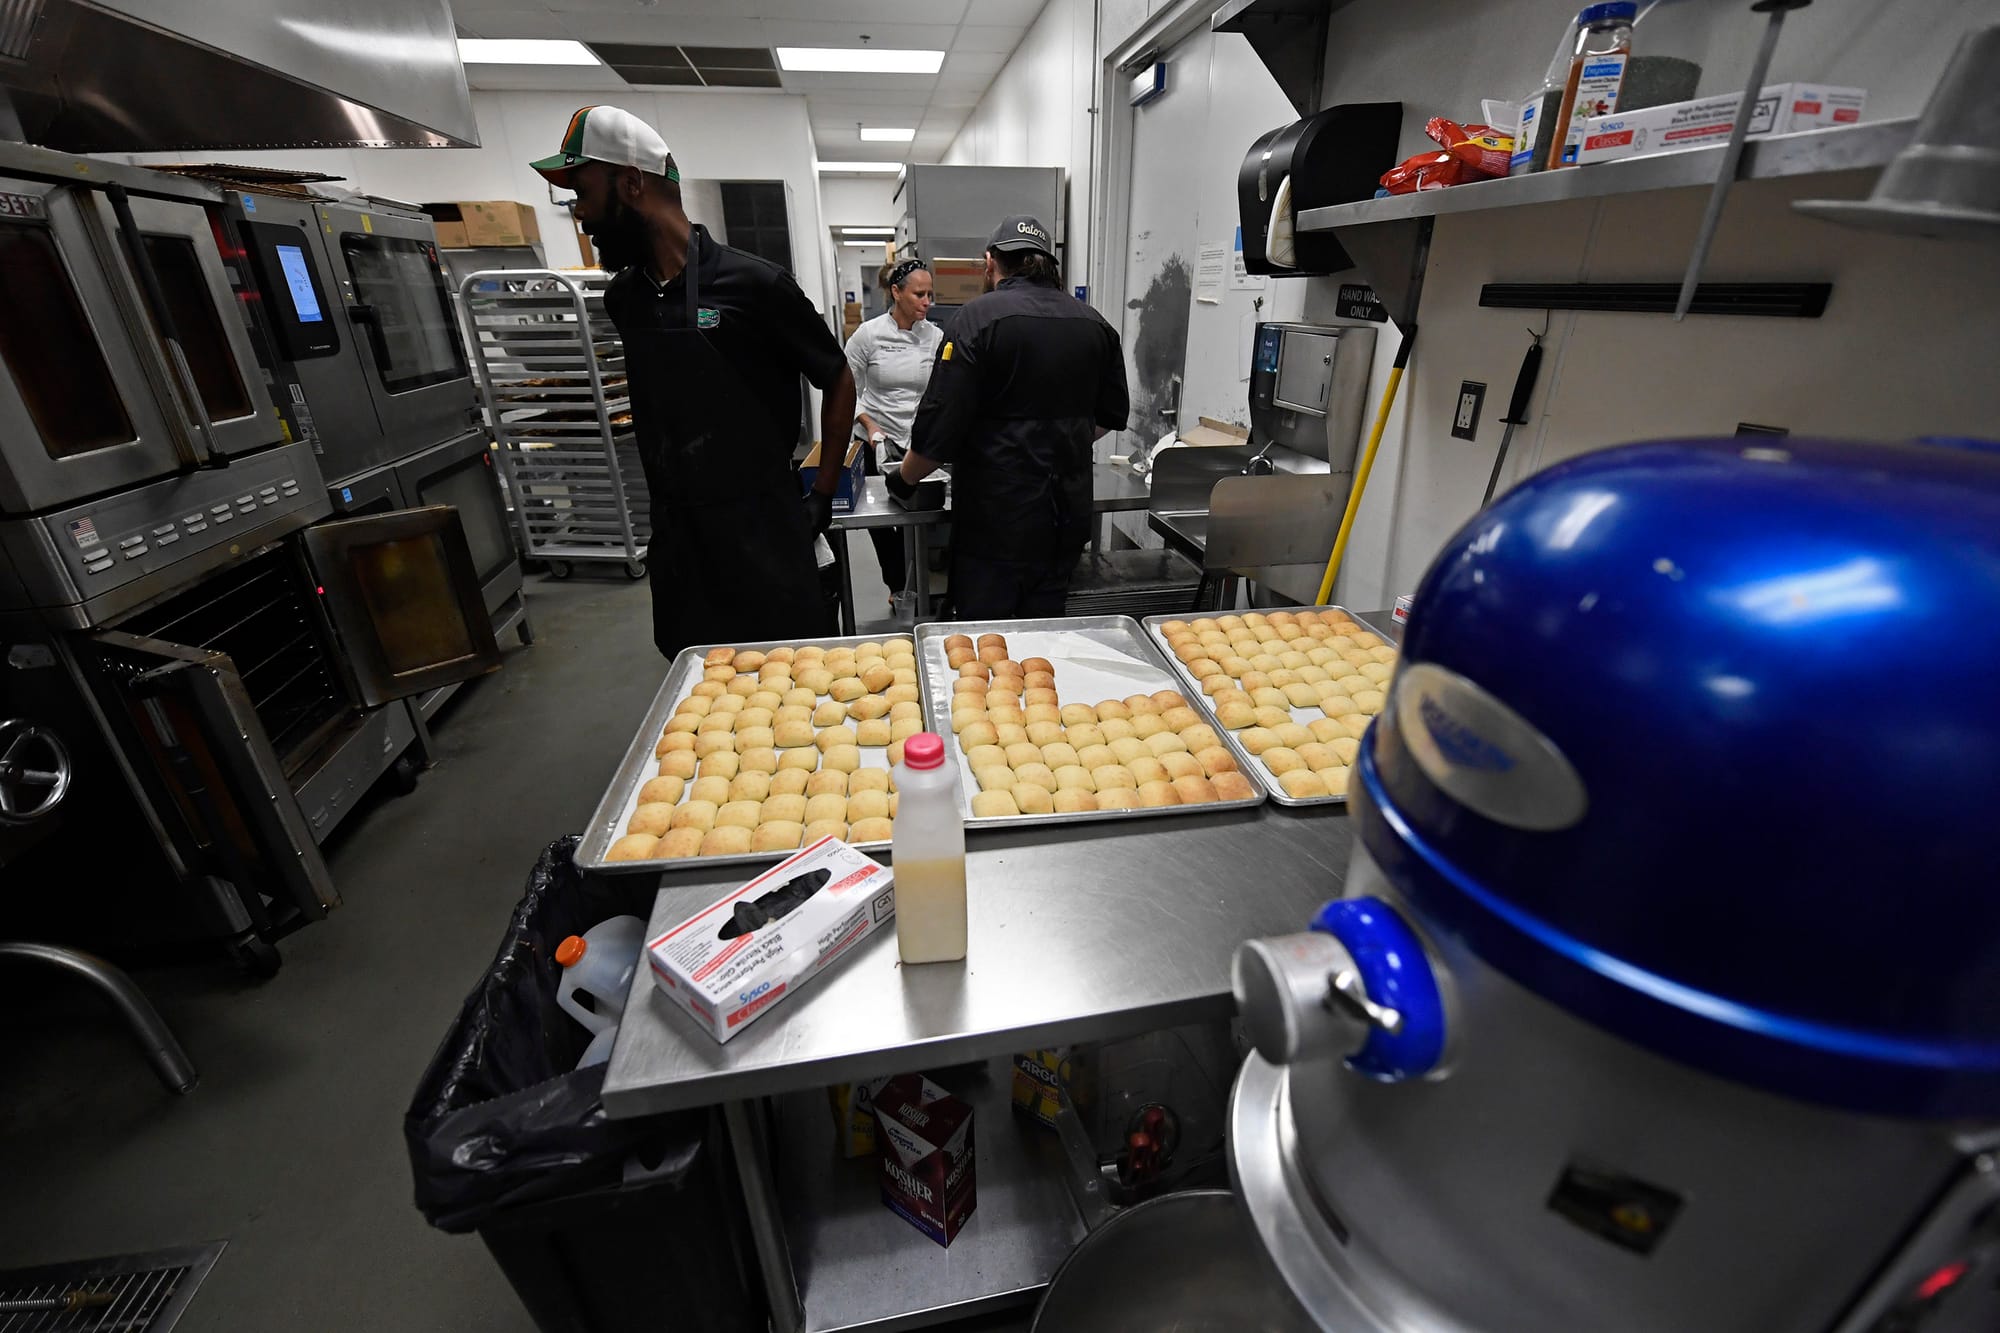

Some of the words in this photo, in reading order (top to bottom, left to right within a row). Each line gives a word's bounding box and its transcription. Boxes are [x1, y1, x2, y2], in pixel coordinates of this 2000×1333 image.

[1600, 121, 1624, 132] Sysco
[1592, 134, 1624, 148] Classic
[1341, 288, 1362, 303] HAND
[1363, 290, 1381, 304] WA
[1350, 306, 1372, 318] ONLY
[740, 982, 770, 1004] Sysco
[898, 1102, 930, 1128] KOSHER
[884, 1157, 934, 1204] KOSHER
